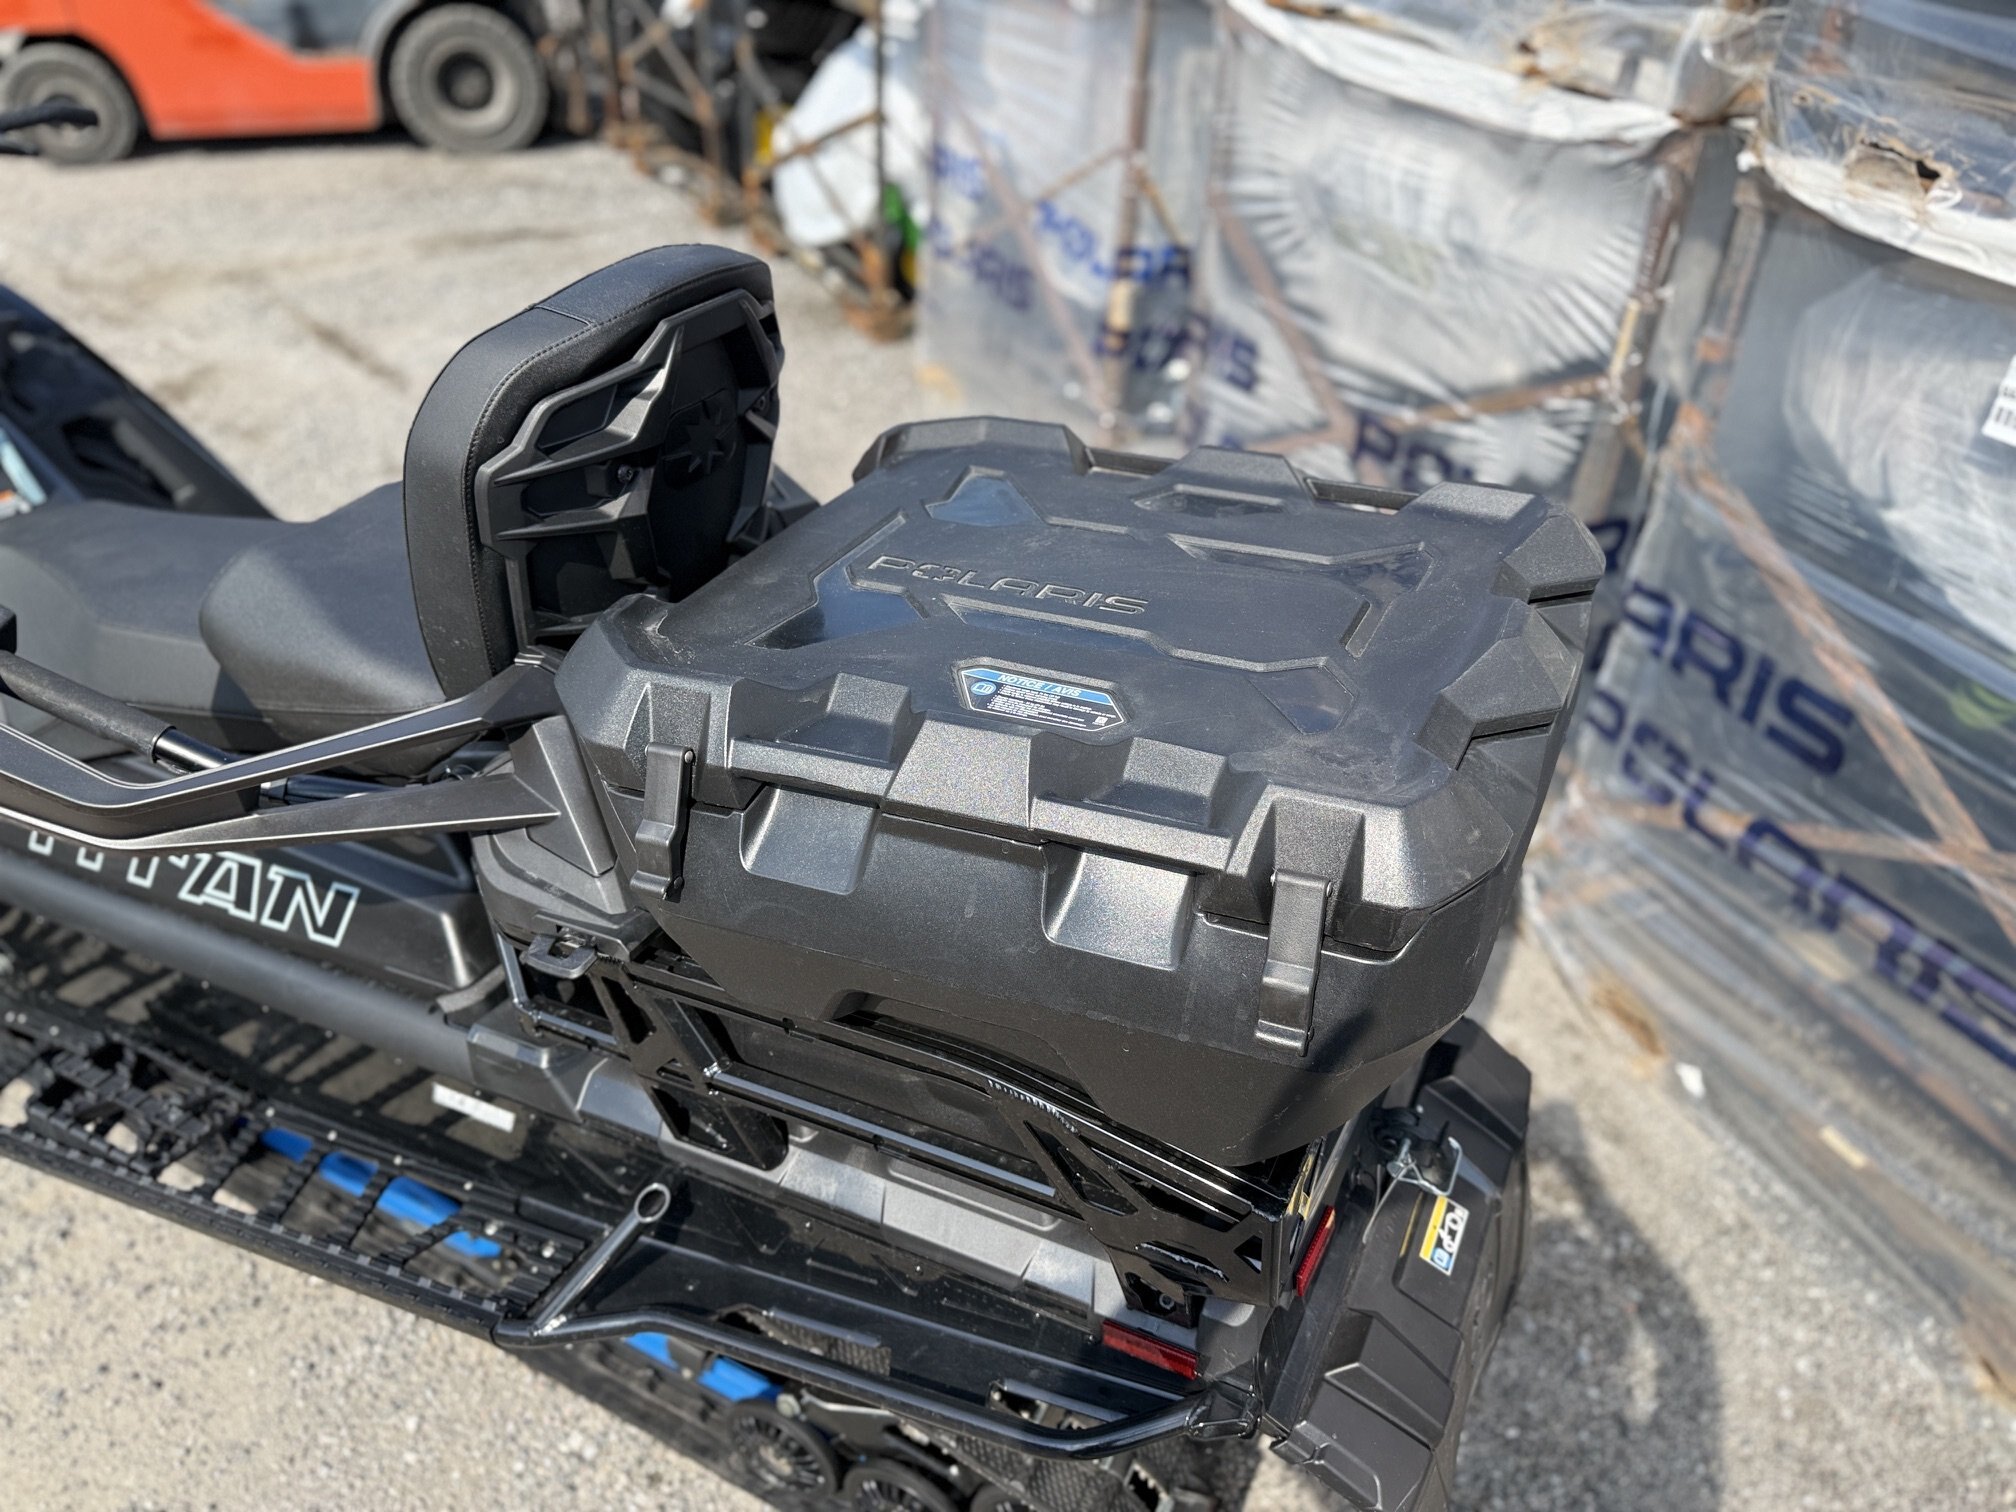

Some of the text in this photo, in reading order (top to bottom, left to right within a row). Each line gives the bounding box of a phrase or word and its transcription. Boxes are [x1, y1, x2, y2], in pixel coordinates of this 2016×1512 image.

[868, 555, 1149, 614] POLARIS
[998, 674, 1043, 690] NOTICE
[1051, 685, 1082, 698] AVIS
[1606, 579, 1853, 778] ARIS
